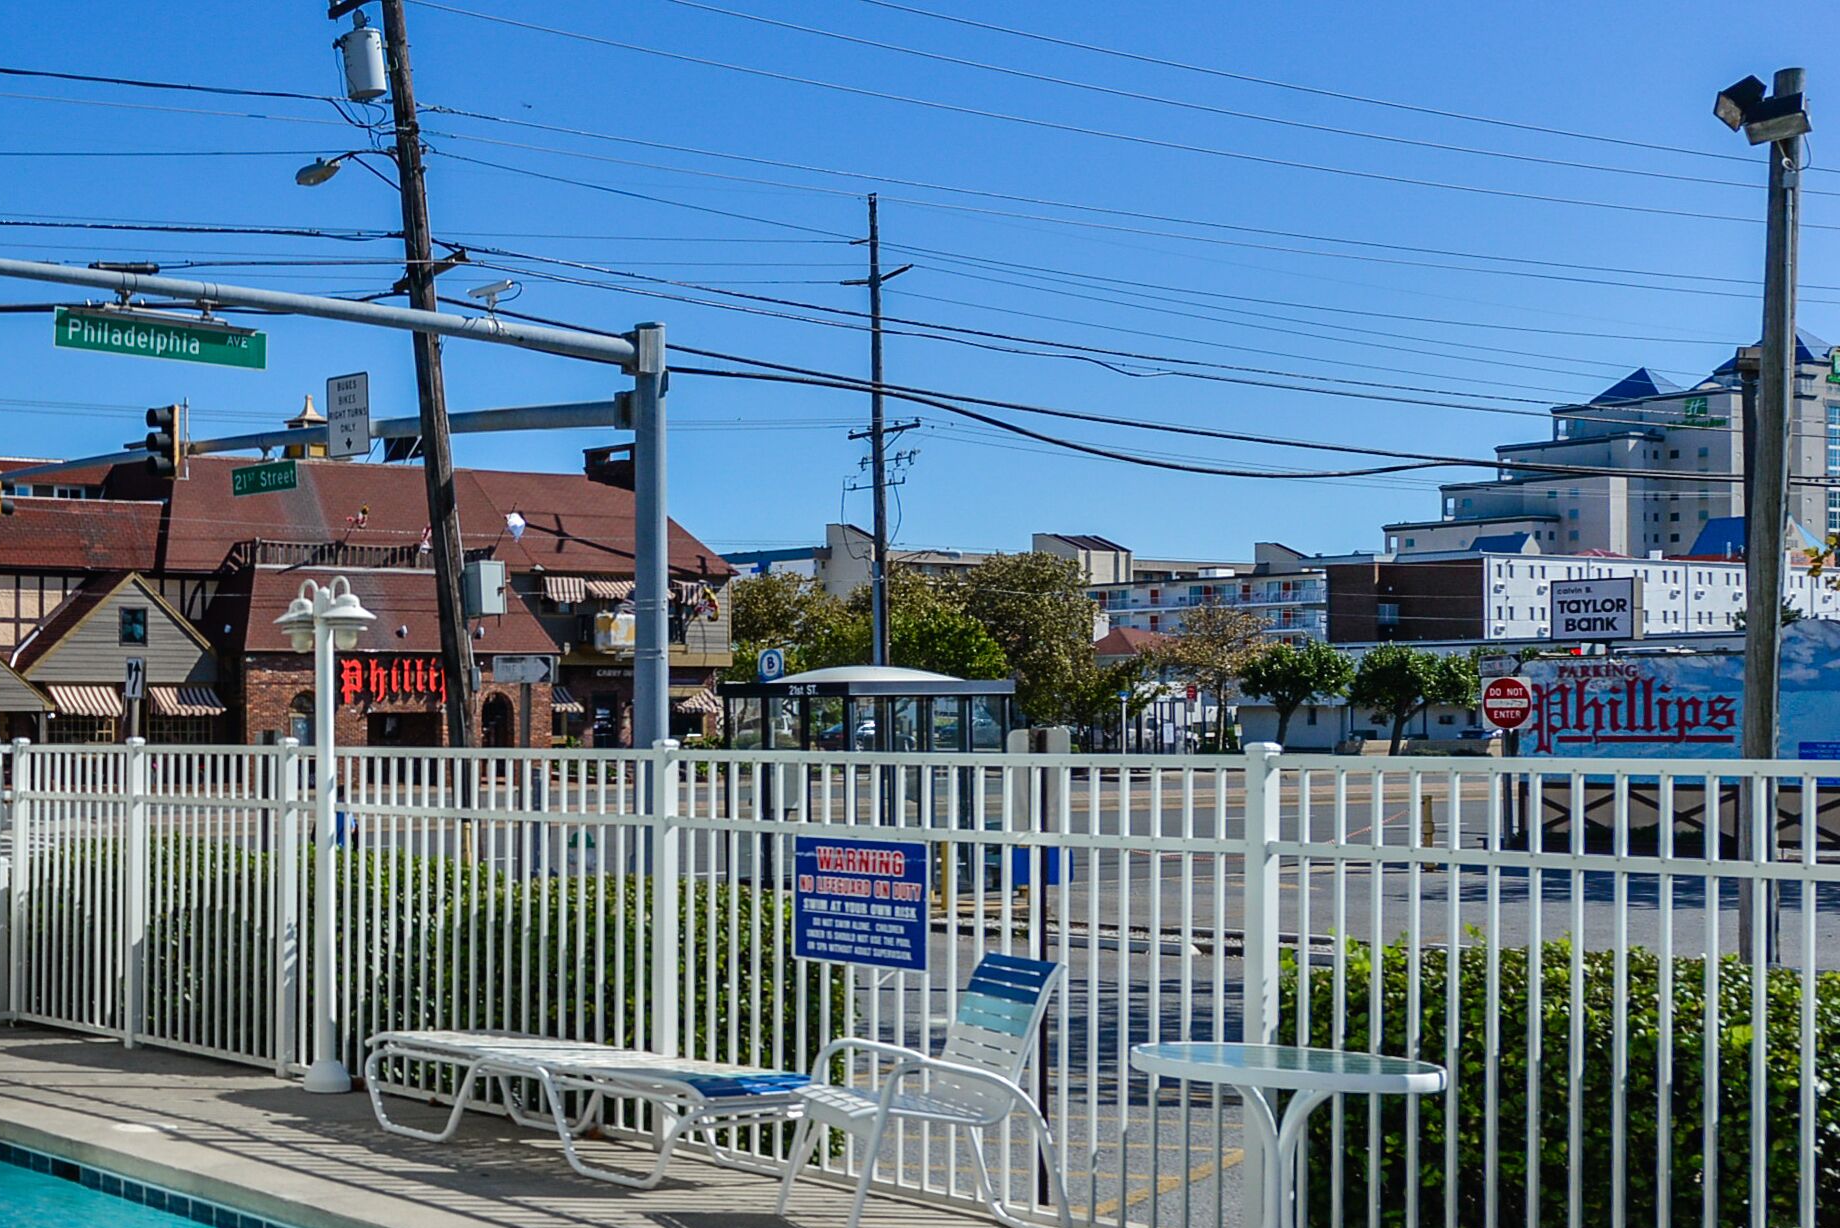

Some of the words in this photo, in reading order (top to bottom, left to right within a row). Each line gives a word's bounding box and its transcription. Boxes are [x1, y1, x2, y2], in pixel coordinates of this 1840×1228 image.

[67, 318, 201, 355] Philadelphia
[226, 335, 249, 349] AVE
[337, 379, 357, 392] BUSES
[338, 395, 357, 406] BIKES
[347, 406, 367, 418] TURNS
[340, 422, 357, 433] ONLY
[260, 469, 295, 488] Street
[1556, 586, 1583, 595] calvin
[766, 656, 775, 670] B
[1557, 663, 1640, 679] PARKING
[788, 684, 805, 696] 21st
[1489, 687, 1502, 697] DO
[1506, 687, 1524, 697] NOT
[1493, 709, 1522, 719] ENTER
[1529, 676, 1737, 754] Phillips
[816, 846, 905, 878] WARNING
[799, 874, 815, 894] NO
[816, 875, 872, 898] LIFEGUARD
[873, 880, 891, 899] ON
[892, 881, 923, 902] DUTY
[803, 897, 828, 911] SWIM
[830, 899, 842, 912] AT
[844, 901, 868, 914] YOUR
[870, 903, 892, 917] OWN
[894, 905, 917, 919] RISK
